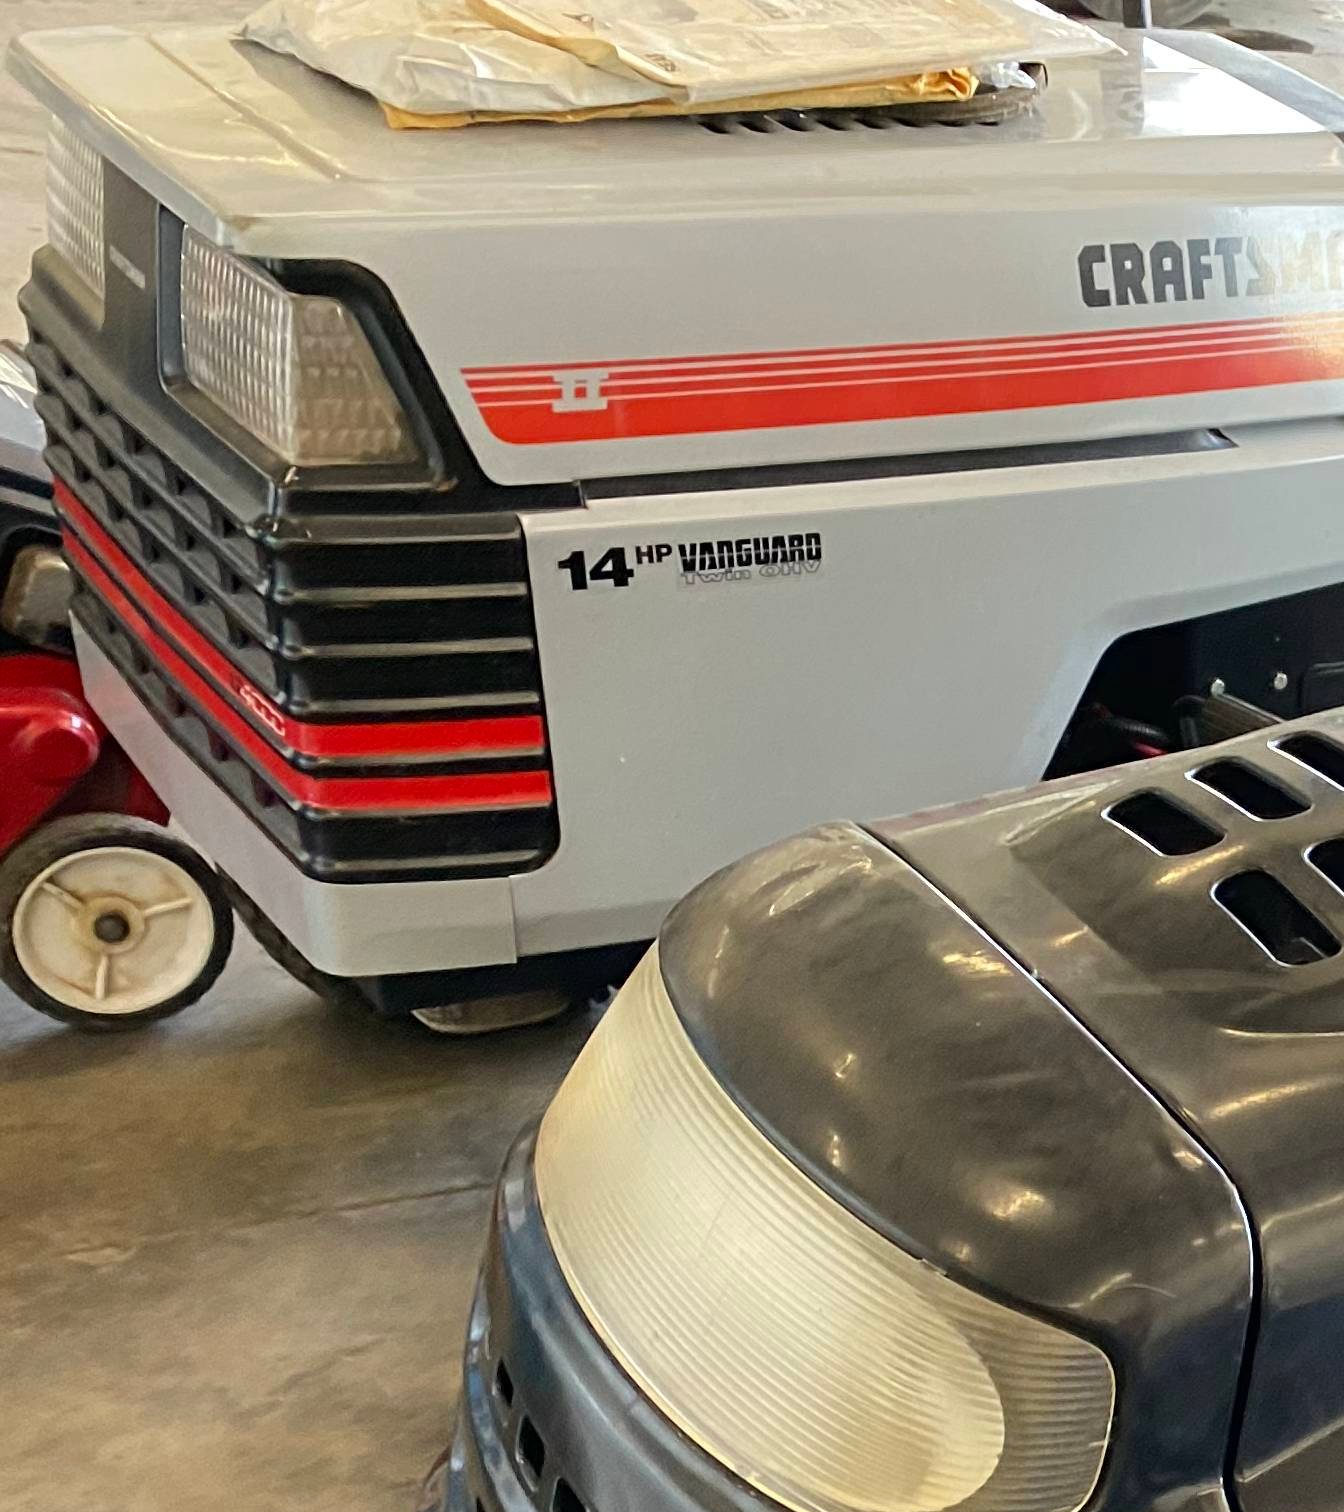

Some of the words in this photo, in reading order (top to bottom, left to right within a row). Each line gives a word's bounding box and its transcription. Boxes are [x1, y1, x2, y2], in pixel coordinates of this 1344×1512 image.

[558, 547, 634, 590] 14
[636, 544, 673, 565] HP
[678, 533, 822, 572] VANGUARD
[681, 567, 750, 585] Twin
[759, 560, 822, 577] OHV
